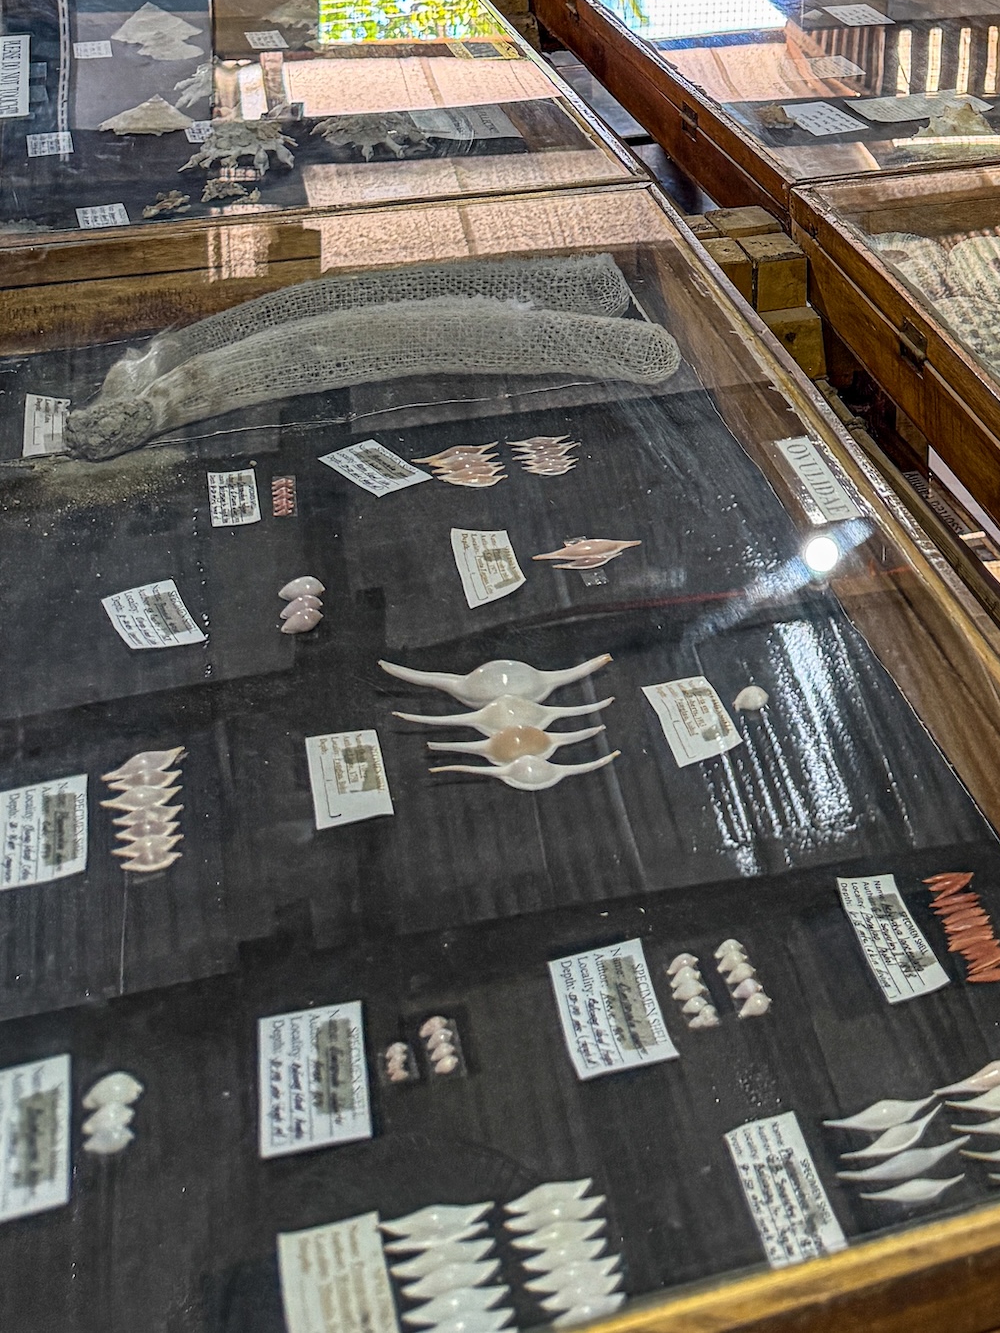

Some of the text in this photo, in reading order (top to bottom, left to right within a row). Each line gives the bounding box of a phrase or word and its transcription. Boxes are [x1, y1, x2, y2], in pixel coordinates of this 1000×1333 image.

[786, 442, 849, 515] OVULIDAE
[839, 882, 853, 906] Depth:
[850, 882, 866, 908] Locality:
[901, 911, 928, 955] SPECIMEN SHELL
[559, 959, 576, 990] Depth:
[575, 955, 595, 997] Locality:
[593, 951, 610, 987] Author:
[611, 947, 626, 979] Name:
[633, 962, 656, 1016] SPECIMEN
[286, 1015, 303, 1062] Locality:
[800, 1157, 821, 1200] SPECIMEN
